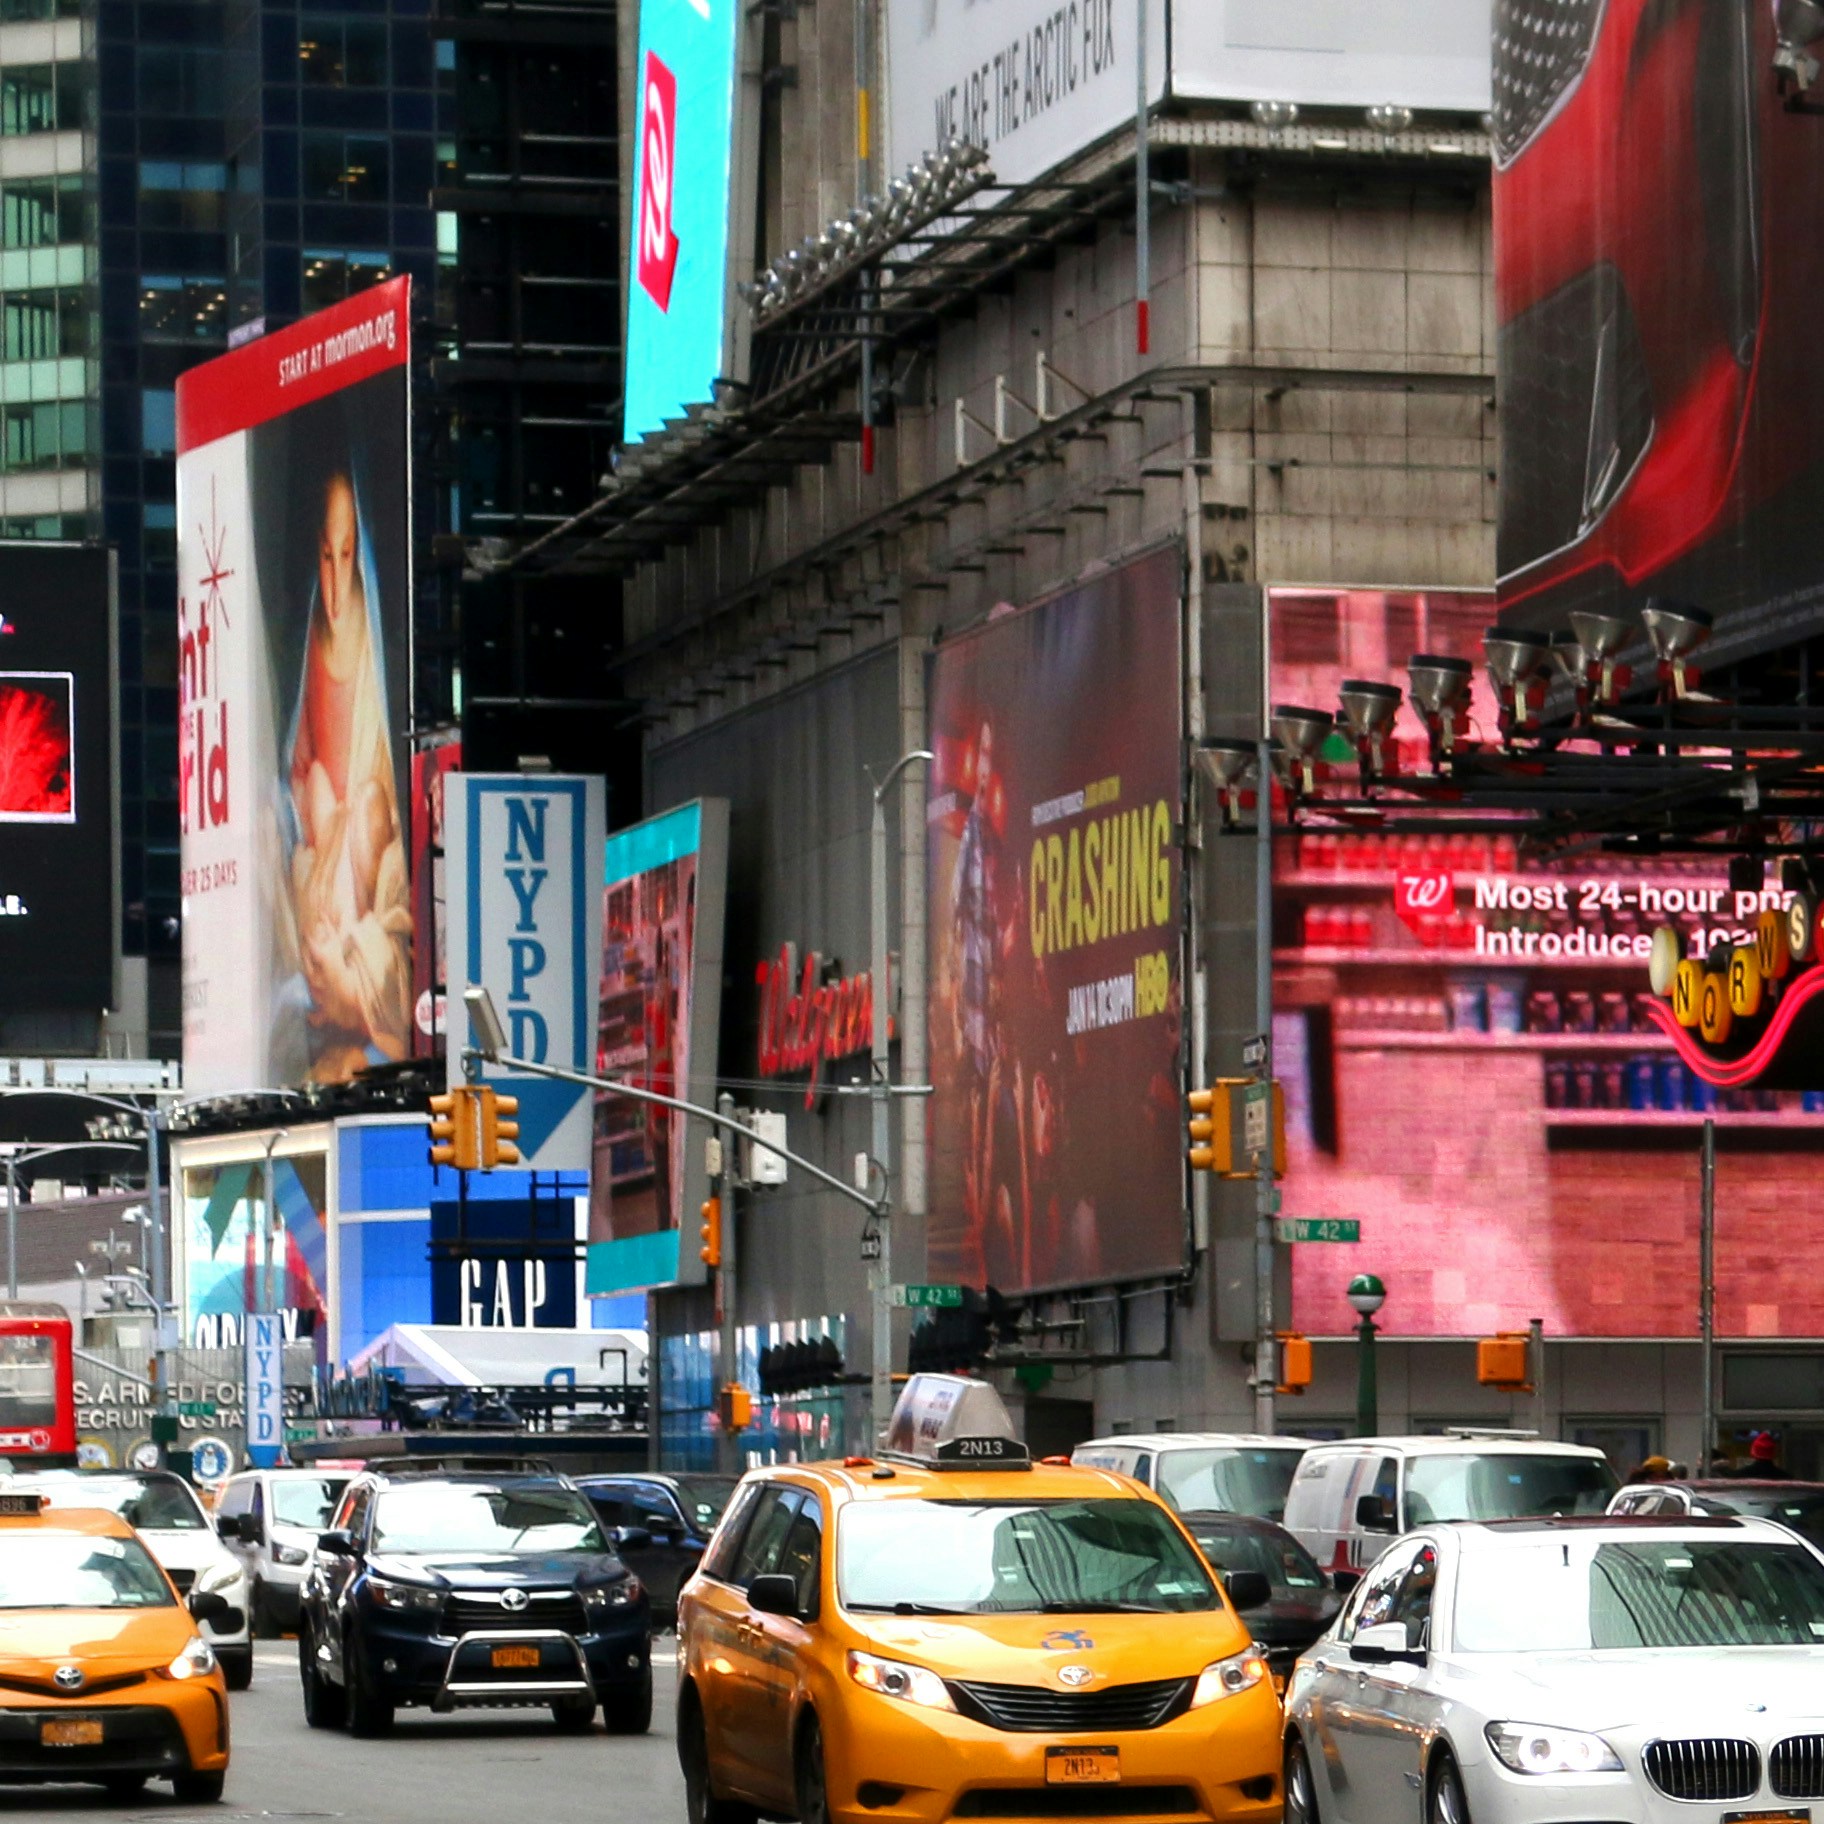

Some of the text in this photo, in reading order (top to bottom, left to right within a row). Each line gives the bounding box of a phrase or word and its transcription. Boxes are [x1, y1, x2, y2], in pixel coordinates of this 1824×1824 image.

[963, 62, 988, 151] ARE
[994, 40, 1018, 142] THE
[1023, 1, 1077, 123] ARCTIC
[278, 309, 396, 388] START AT mormon.org
[1030, 799, 1171, 959] CRASHING
[1474, 880, 1568, 912] Most
[1579, 879, 1720, 913] 24-hour
[504, 798, 548, 1073] NYPD
[1474, 925, 1653, 958] Introduce
[1134, 950, 1169, 1018] HBO
[1676, 976, 1690, 1015] N
[1703, 989, 1717, 1029] Q
[1732, 967, 1745, 1003] R
[1757, 928, 1776, 963] W
[1790, 914, 1804, 951] S
[1297, 1220, 1309, 1237] W
[1317, 1221, 1340, 1240] 42
[460, 1258, 547, 1328] GAP
[927, 1288, 942, 1305] 42
[256, 1318, 273, 1441] NYPD
[960, 1441, 1003, 1456] 2N13
